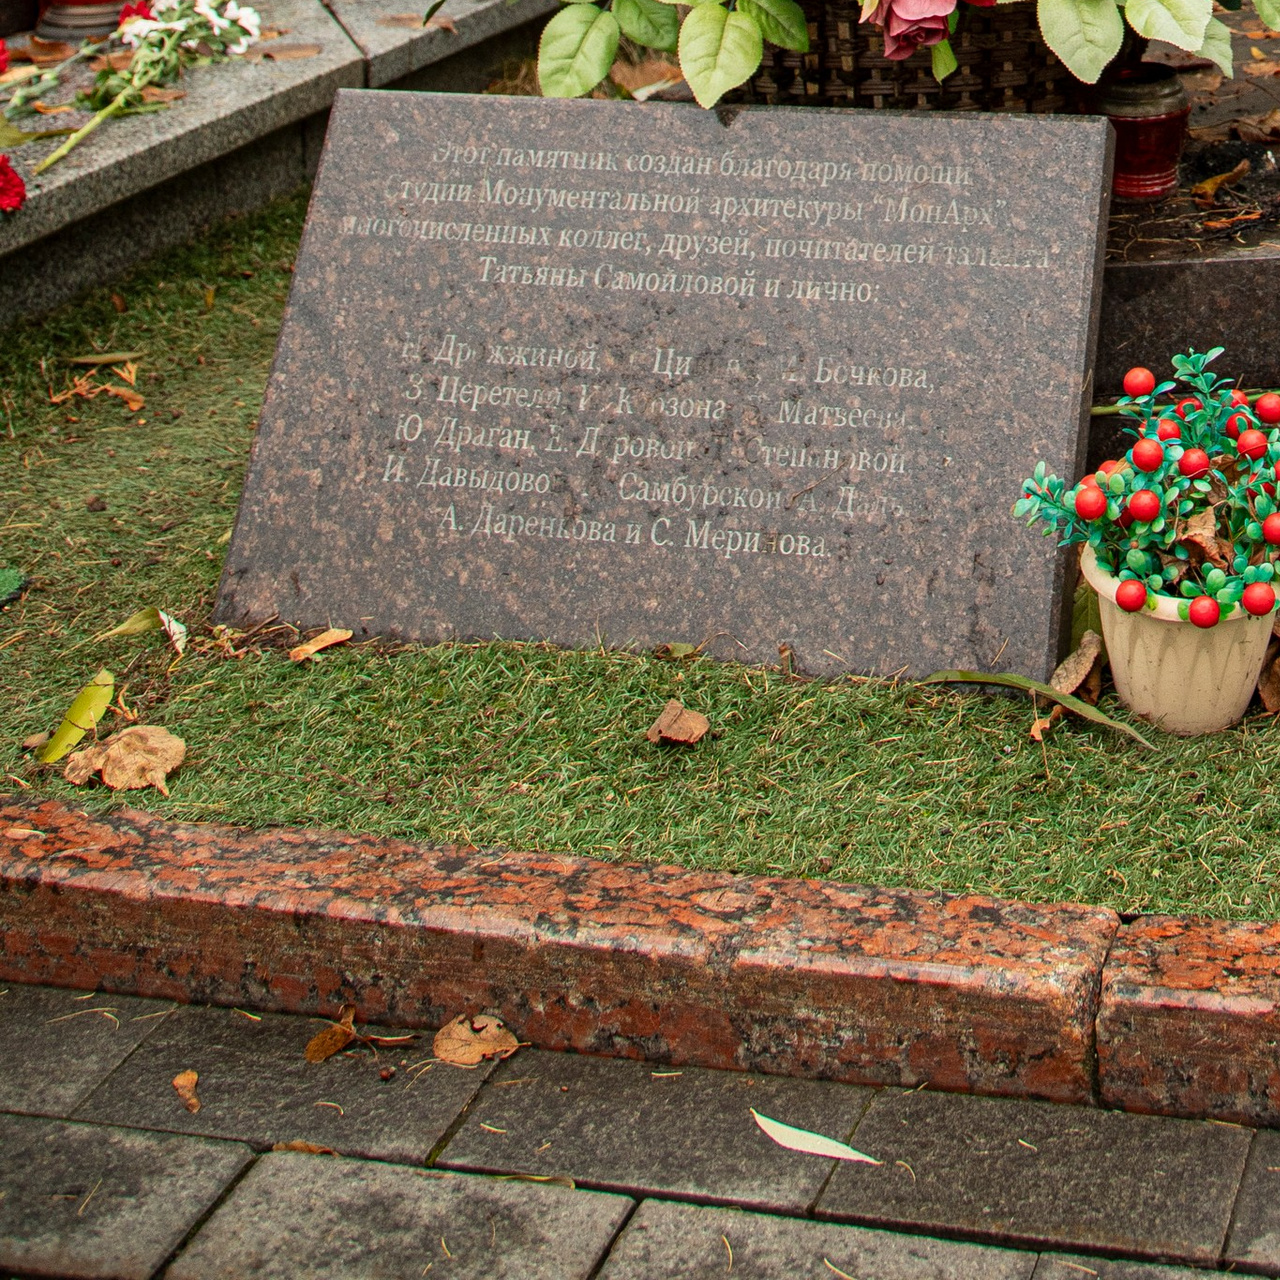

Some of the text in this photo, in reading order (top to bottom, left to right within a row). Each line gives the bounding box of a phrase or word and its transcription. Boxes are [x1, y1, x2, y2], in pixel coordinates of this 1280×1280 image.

[432, 143, 973, 187] Этот памятник создан благодаря помощи
[385, 173, 472, 205] Студии
[479, 177, 701, 215] Монументальной
[558, 227, 652, 257] коллег,
[658, 228, 756, 262] друзей,
[764, 237, 934, 265] почитателей
[479, 255, 881, 304] Татьяны Самойловой и лично:
[416, 457, 552, 495] Давыдово
[438, 501, 464, 532] А.
[470, 504, 617, 543] Даренкова
[624, 522, 643, 545] и
[650, 517, 675, 547] С.
